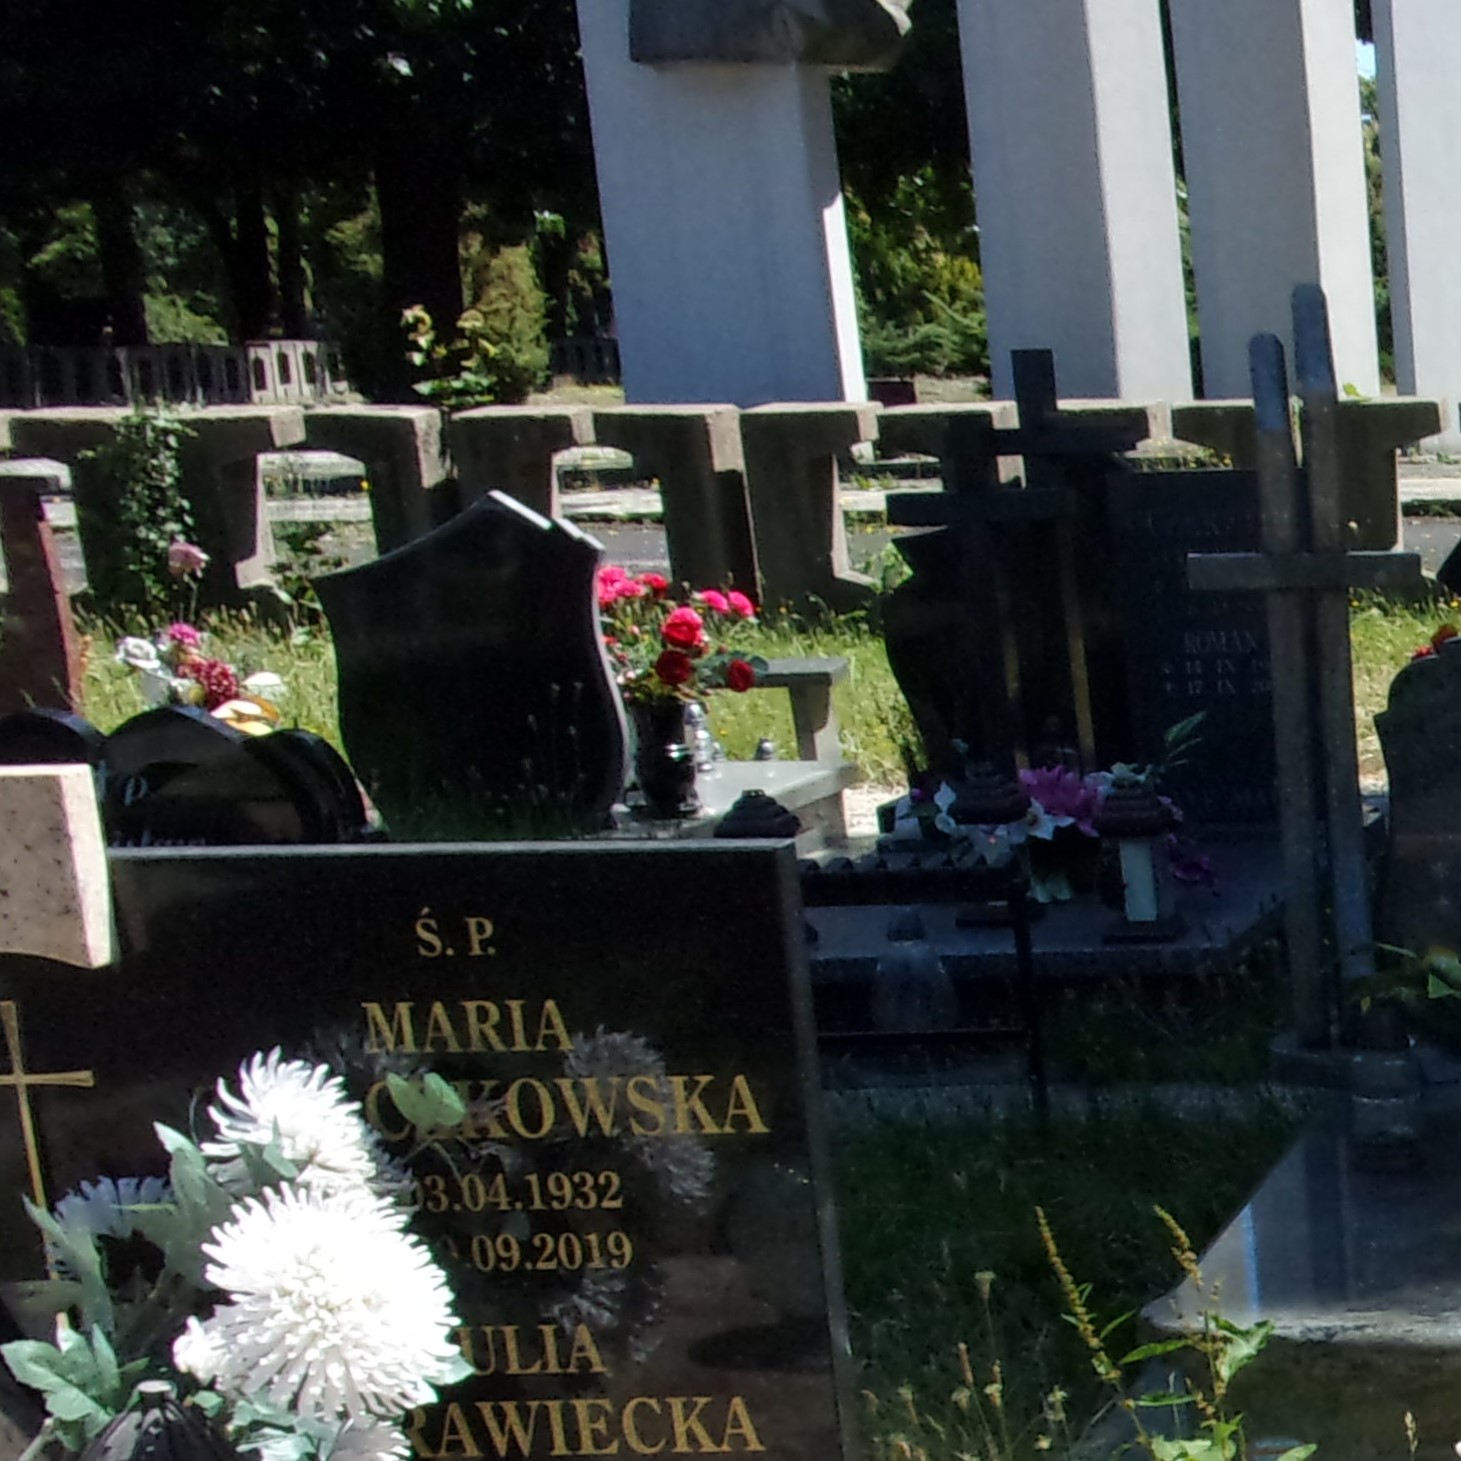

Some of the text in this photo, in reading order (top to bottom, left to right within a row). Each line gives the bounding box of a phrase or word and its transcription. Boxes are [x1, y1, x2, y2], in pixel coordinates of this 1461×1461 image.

[415, 908, 497, 957] Ś. P.
[361, 998, 577, 1055] MARIA
[454, 1321, 609, 1377] ULIA
[406, 1396, 766, 1459] RAWIECKA
